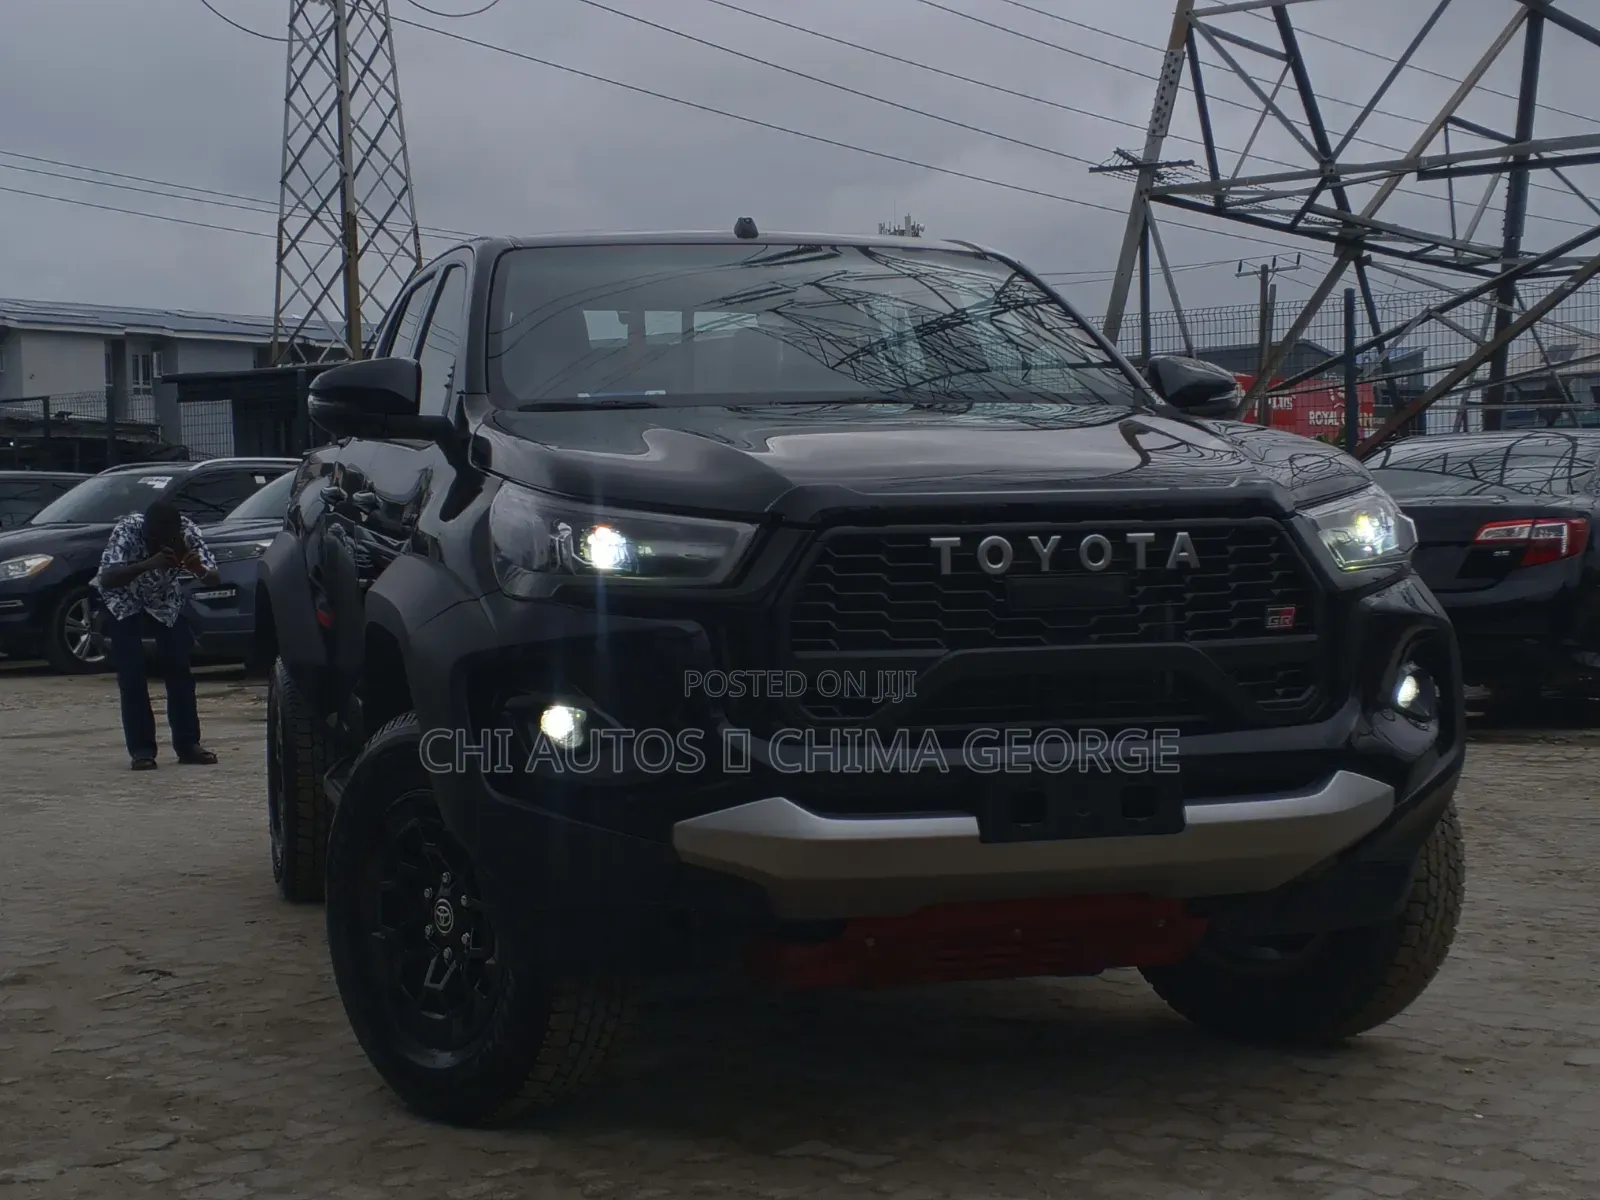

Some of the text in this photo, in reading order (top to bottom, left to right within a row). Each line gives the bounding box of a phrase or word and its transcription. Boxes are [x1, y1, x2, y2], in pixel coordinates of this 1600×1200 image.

[1308, 410, 1340, 426] ROYAL
[930, 532, 1200, 575] TOYOTA
[1266, 614, 1293, 627] GR
